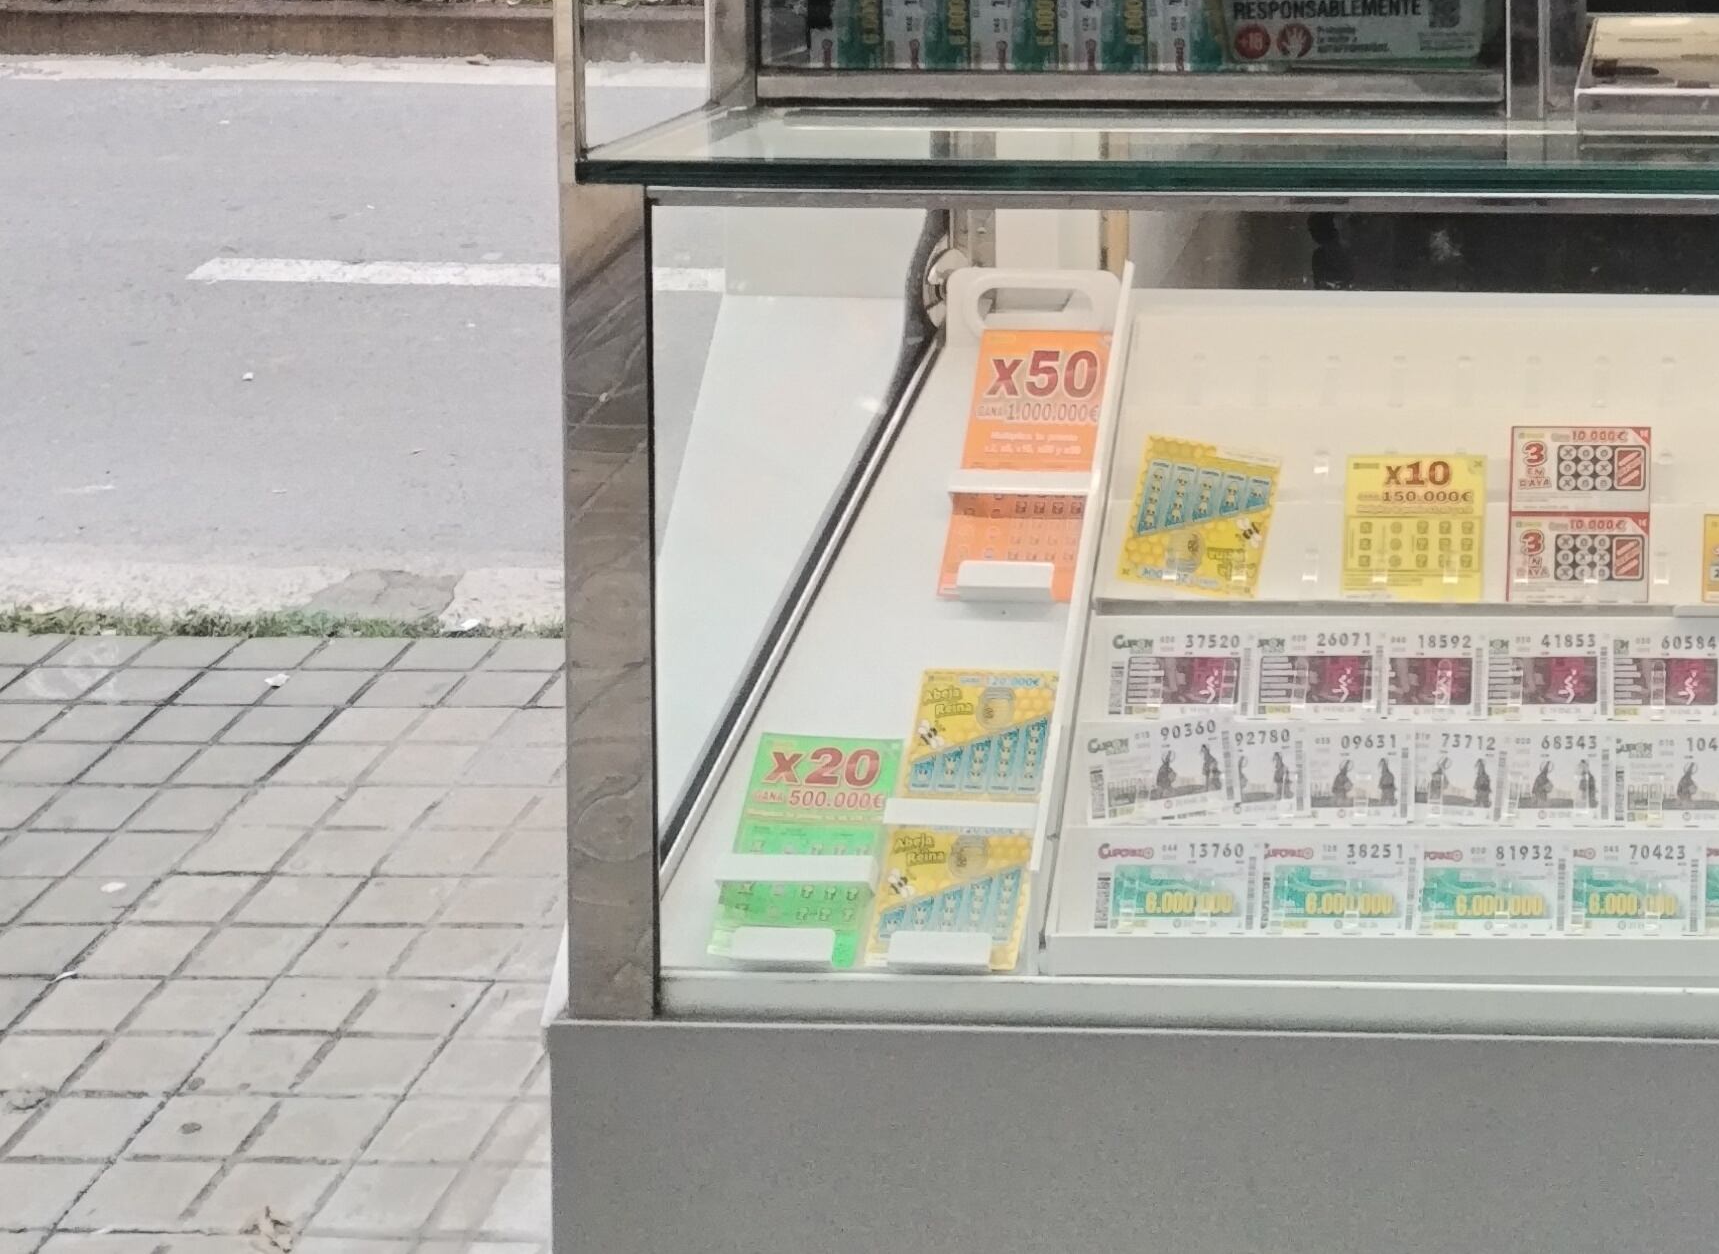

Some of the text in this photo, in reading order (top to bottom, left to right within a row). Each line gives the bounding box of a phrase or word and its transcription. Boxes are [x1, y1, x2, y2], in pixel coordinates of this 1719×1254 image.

[985, 349, 1099, 399] x50
[1524, 440, 1547, 466] 3
[1385, 460, 1451, 486] x10
[1521, 530, 1544, 555] 3
[1184, 633, 1240, 649] 37520
[1317, 632, 1371, 647] 26071
[1418, 634, 1472, 649] 18592
[1540, 633, 1596, 648] 41853
[1661, 634, 1718, 649] 60584
[1160, 719, 1217, 740] 90360
[1234, 728, 1291, 746] 92780
[1340, 734, 1396, 749] 09631
[1440, 732, 1496, 751] 73712
[1541, 734, 1597, 749] 68343
[763, 746, 881, 788] x20
[788, 789, 884, 809] 500.000€
[1188, 843, 1244, 858] 13760
[1495, 844, 1553, 860] 81932
[1629, 843, 1686, 860] 70423
